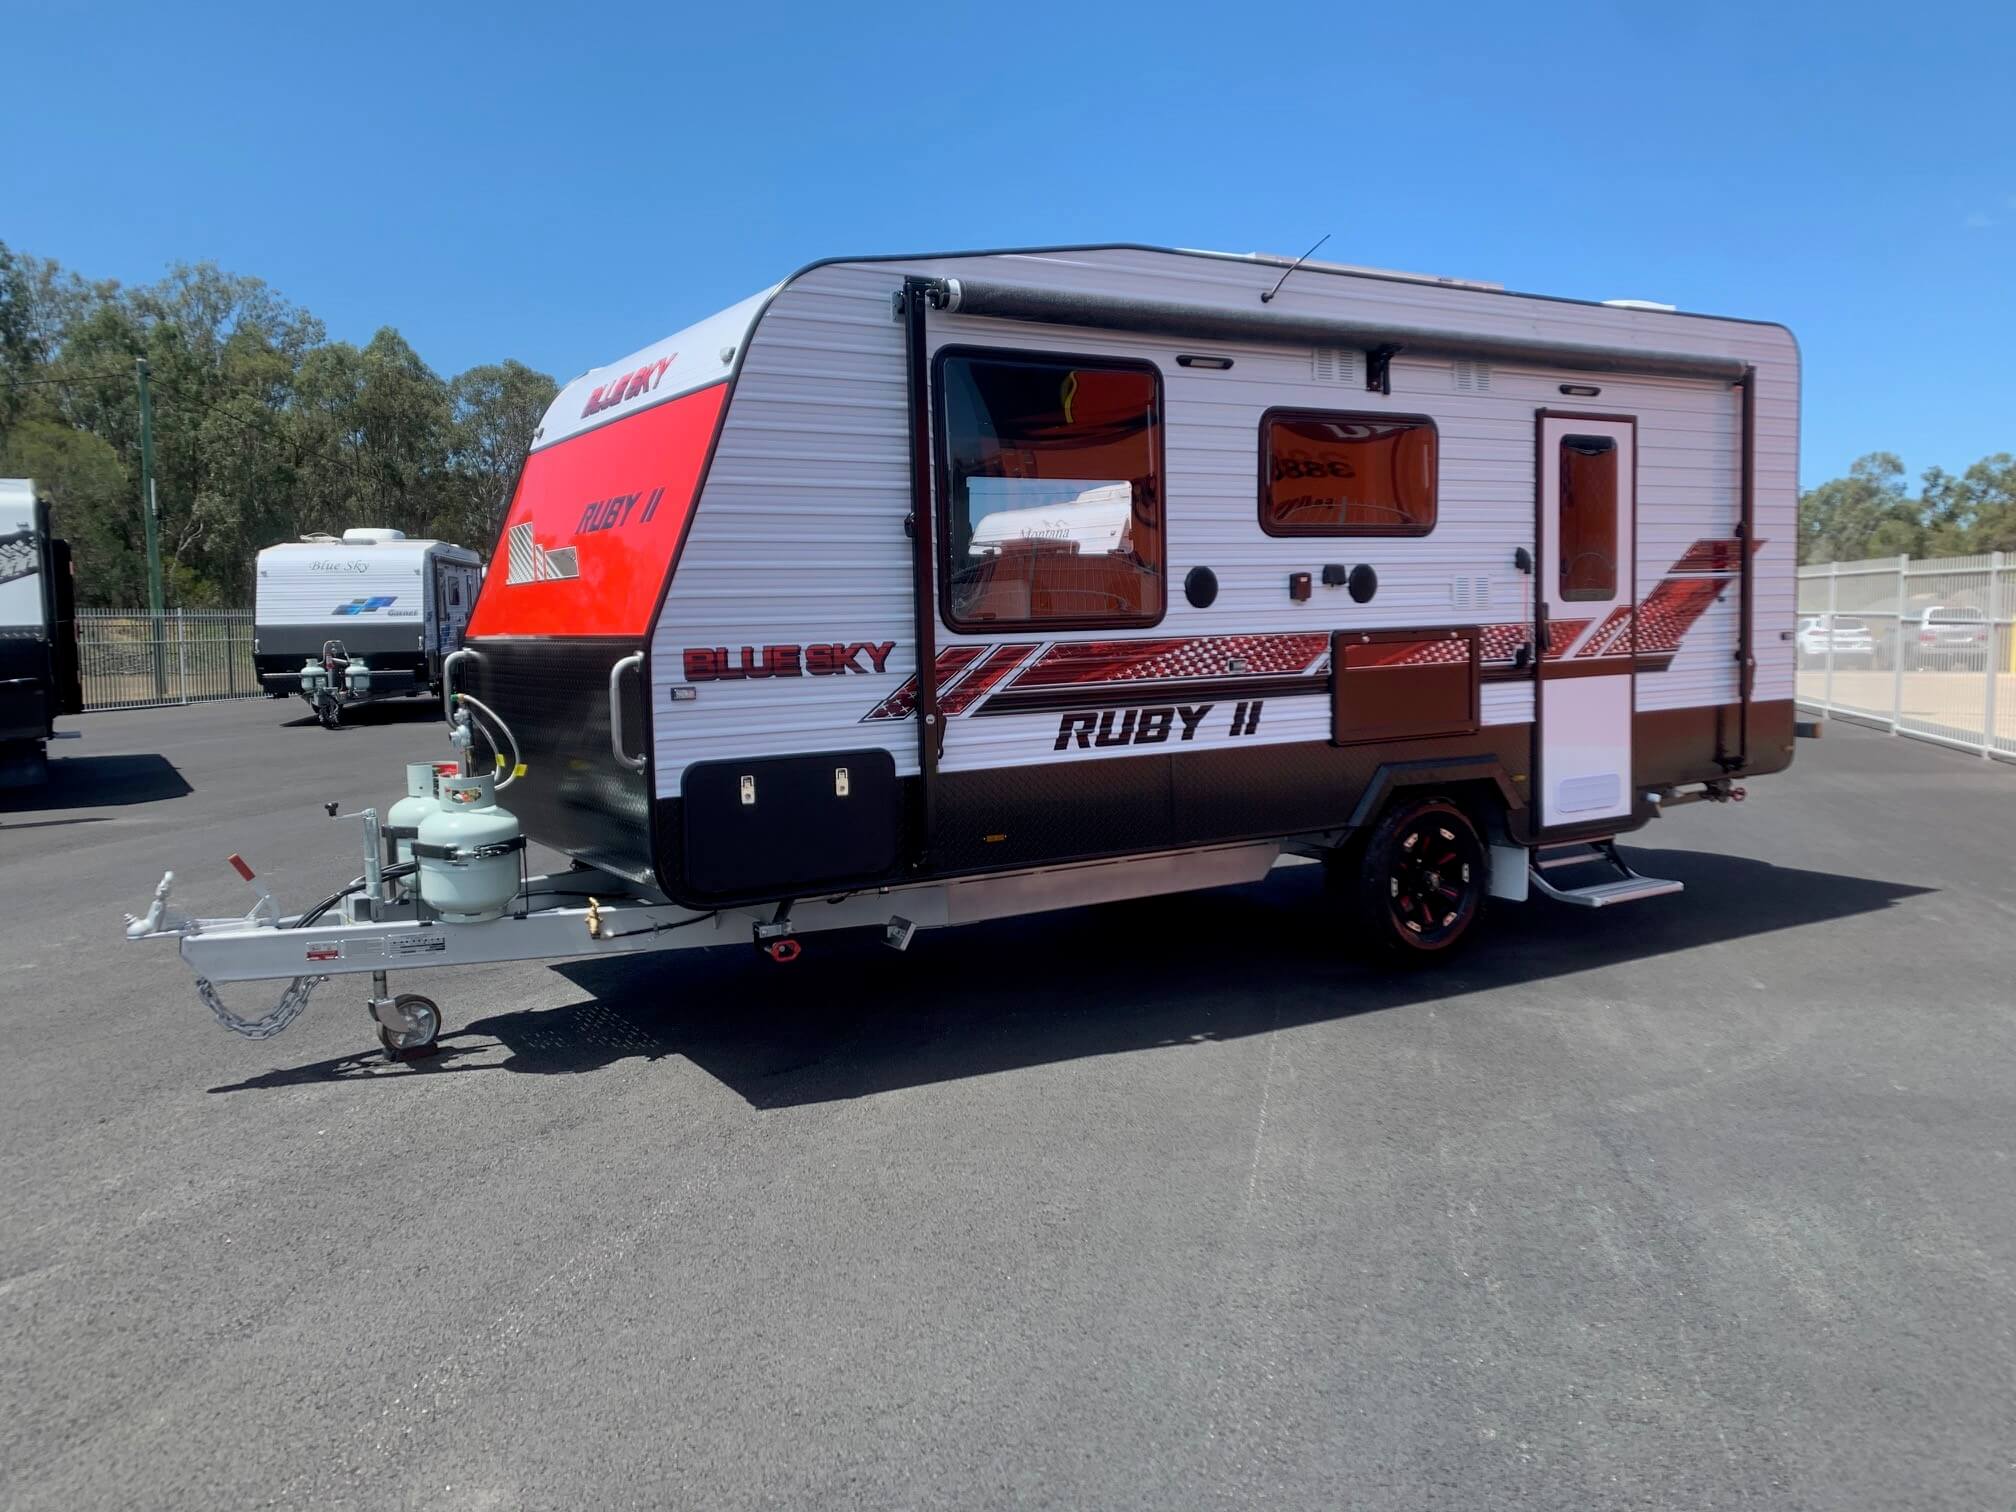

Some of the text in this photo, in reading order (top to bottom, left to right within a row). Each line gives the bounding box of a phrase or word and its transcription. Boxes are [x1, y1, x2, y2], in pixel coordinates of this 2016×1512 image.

[575, 487, 665, 535] RUBY II
[1020, 527, 1070, 539] Montana
[311, 559, 370, 573] Blue Sky
[1053, 701, 1264, 751] RUBY II
